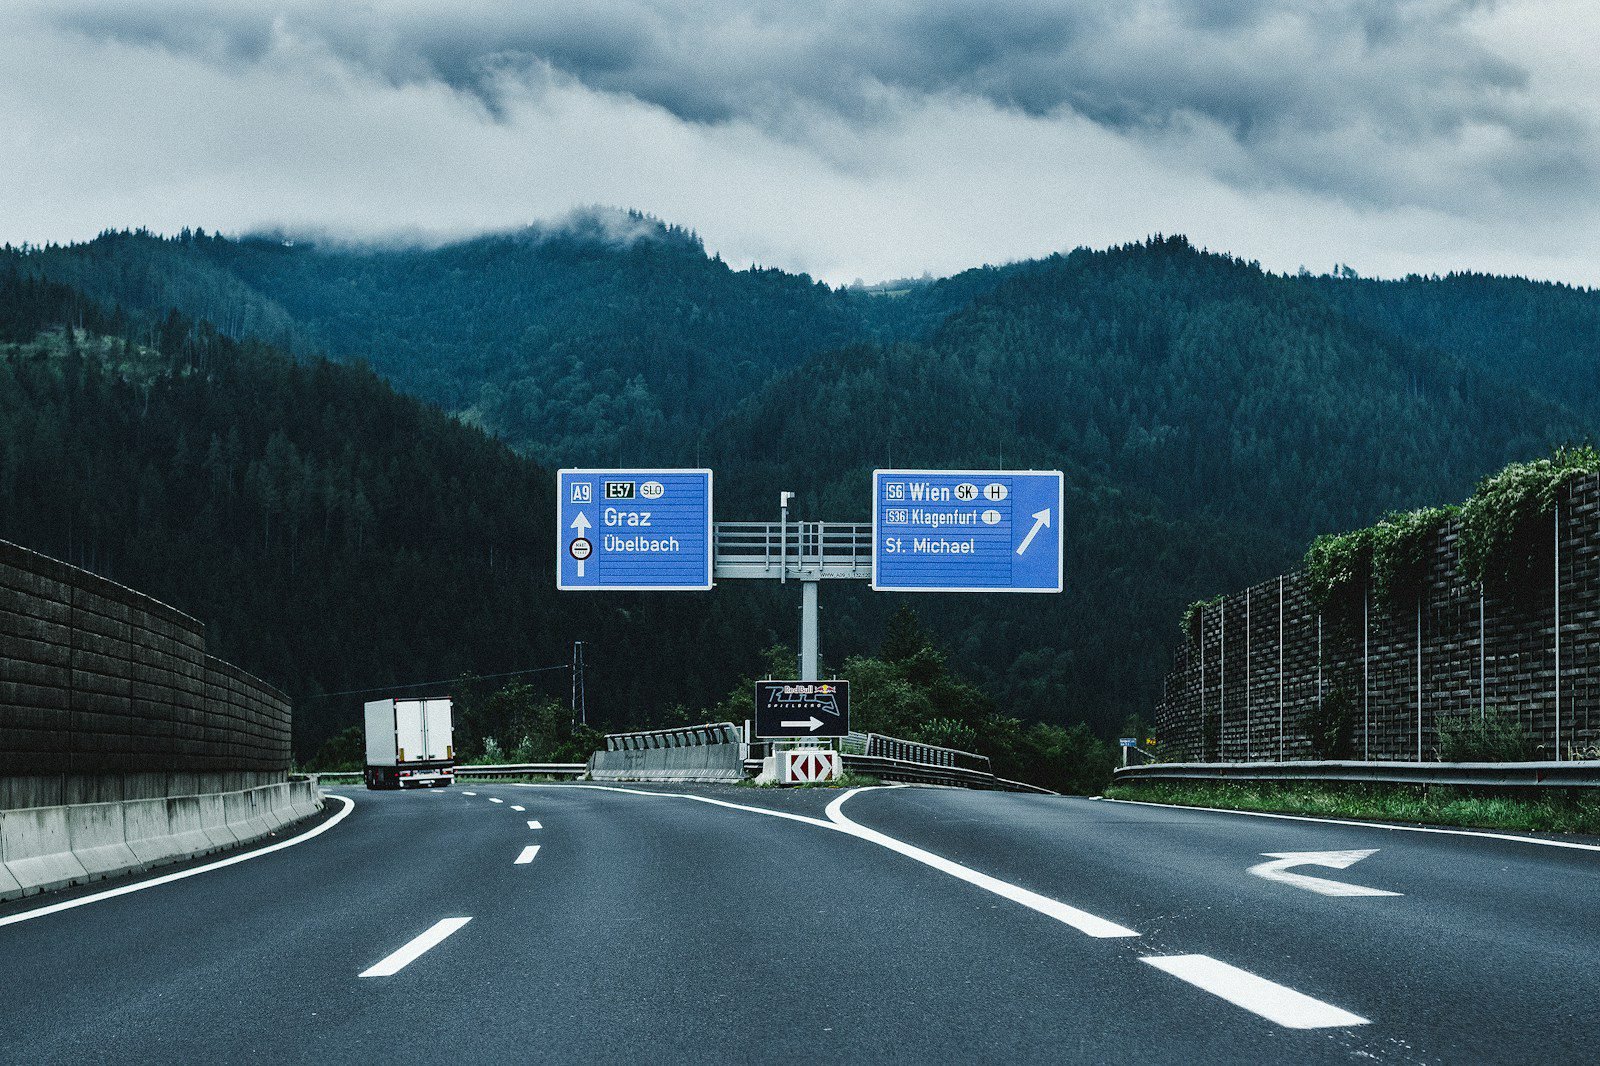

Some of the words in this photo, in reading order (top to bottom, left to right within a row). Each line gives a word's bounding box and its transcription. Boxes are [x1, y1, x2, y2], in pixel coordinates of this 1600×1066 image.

[573, 485, 590, 501] A9
[609, 483, 630, 497] E57
[643, 485, 662, 495] SLO
[888, 484, 903, 497] S6
[909, 482, 950, 501] Wien
[958, 485, 973, 499] SK
[991, 486, 1000, 498] H
[604, 507, 652, 527] Graz
[888, 511, 906, 522] S36
[912, 508, 977, 528] Klagenfurt
[604, 534, 679, 552] Übelbach
[885, 537, 906, 553] St.
[913, 538, 975, 554] Michael
[784, 685, 798, 694] Red
[799, 685, 814, 694] Bull
